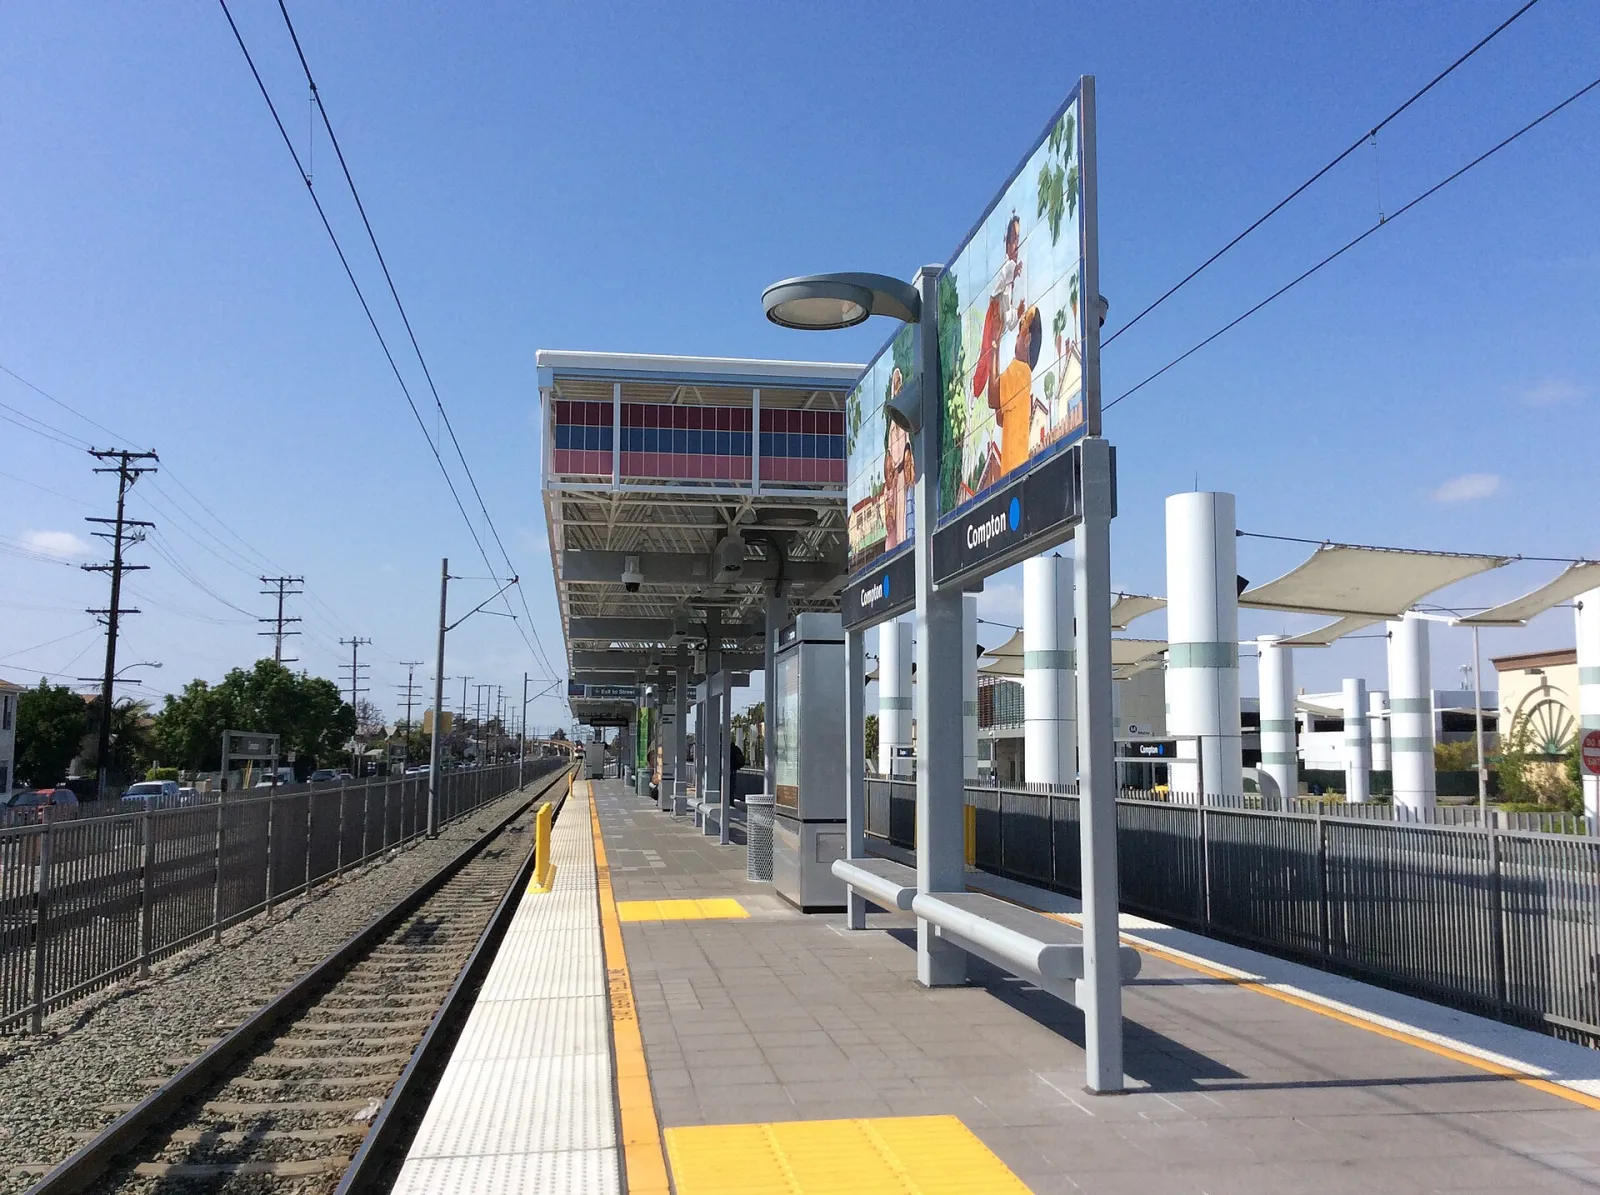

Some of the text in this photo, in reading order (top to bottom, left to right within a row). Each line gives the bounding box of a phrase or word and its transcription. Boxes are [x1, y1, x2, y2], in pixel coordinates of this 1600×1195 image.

[967, 512, 1006, 549] Compton
[861, 584, 882, 608] Compton
[1140, 745, 1158, 756] Compton
